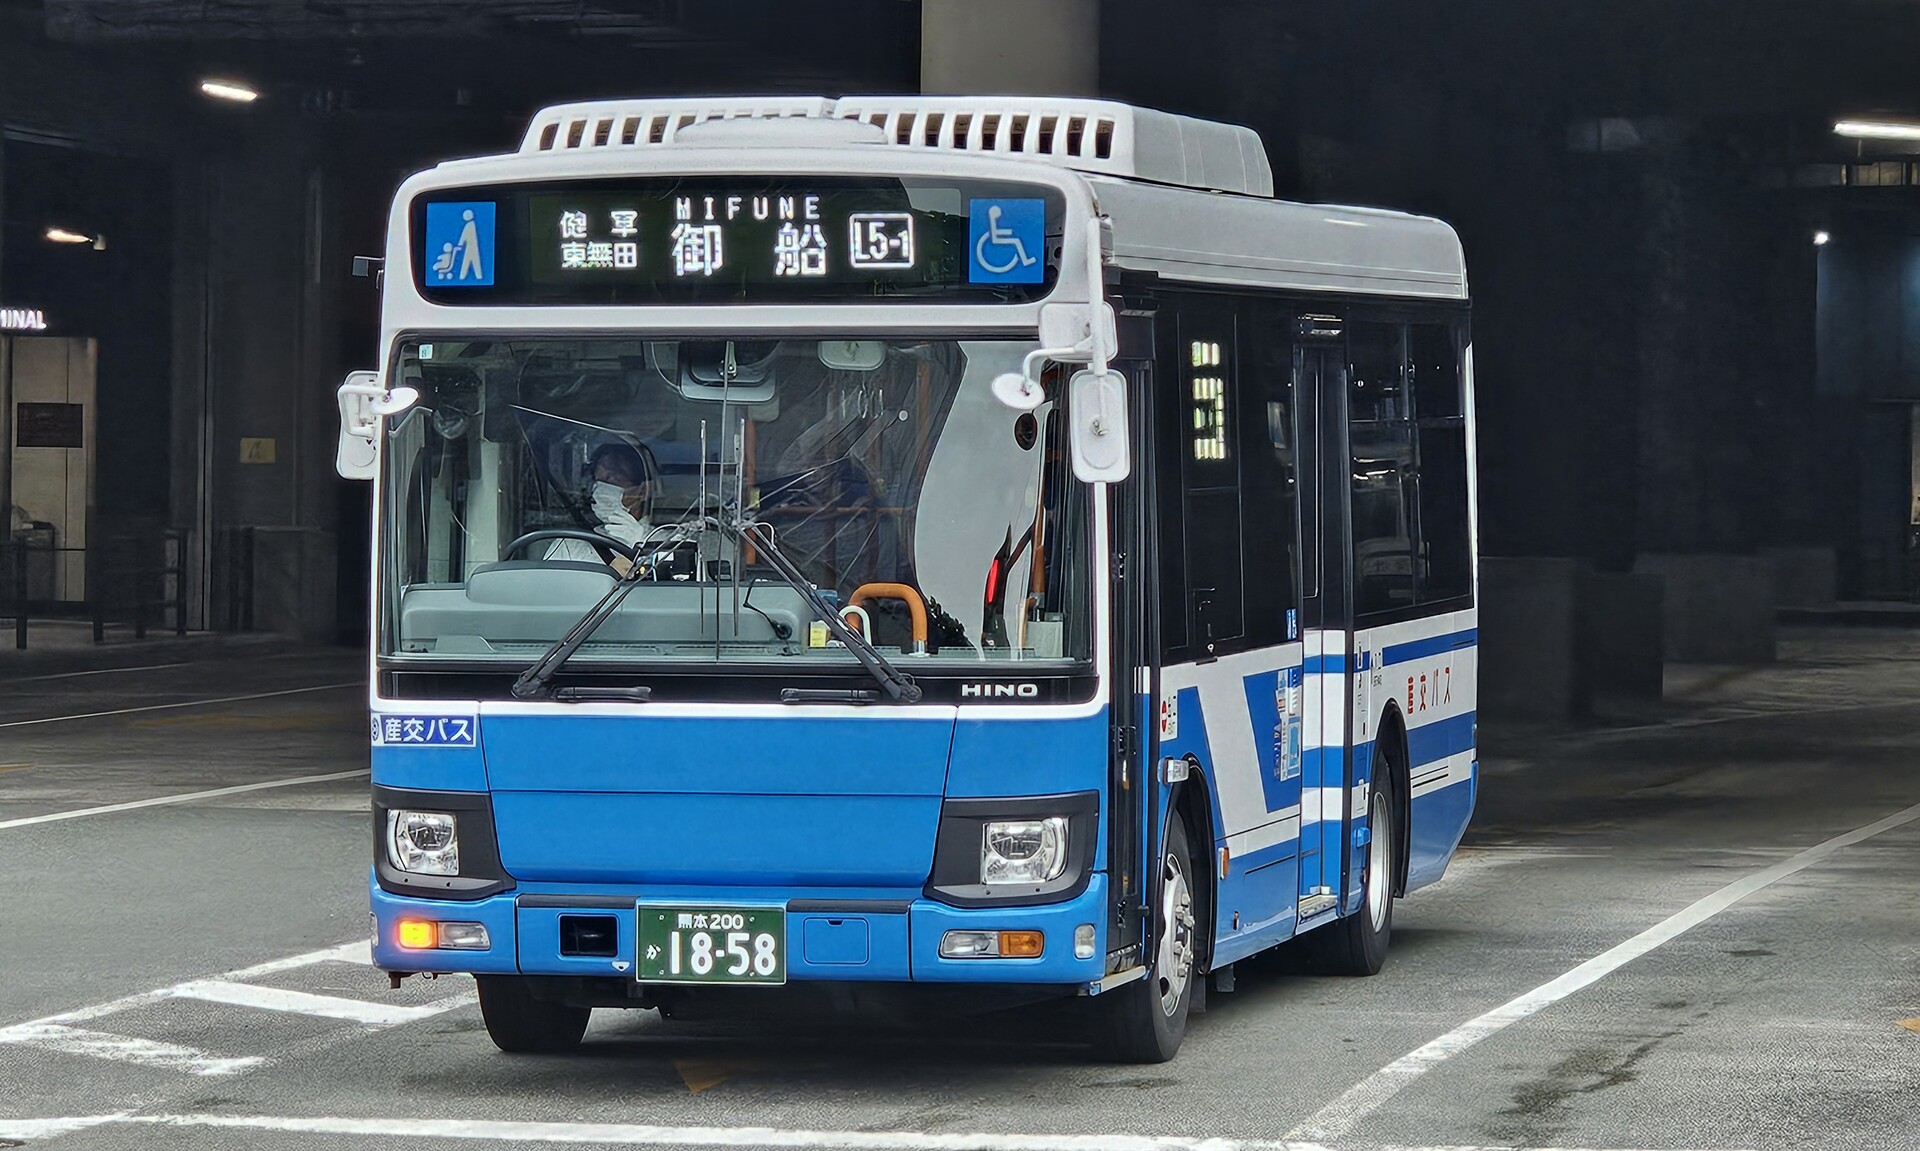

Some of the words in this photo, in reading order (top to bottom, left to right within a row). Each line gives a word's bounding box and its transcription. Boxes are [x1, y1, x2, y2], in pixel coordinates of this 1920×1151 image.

[676, 196, 820, 220] MIFUNE
[671, 221, 828, 277] 御船
[854, 221, 909, 260] L5-1
[561, 241, 637, 269] 東無田
[961, 683, 1038, 697] HINO
[385, 717, 472, 742] 産交バス
[671, 931, 777, 976] 18-58
